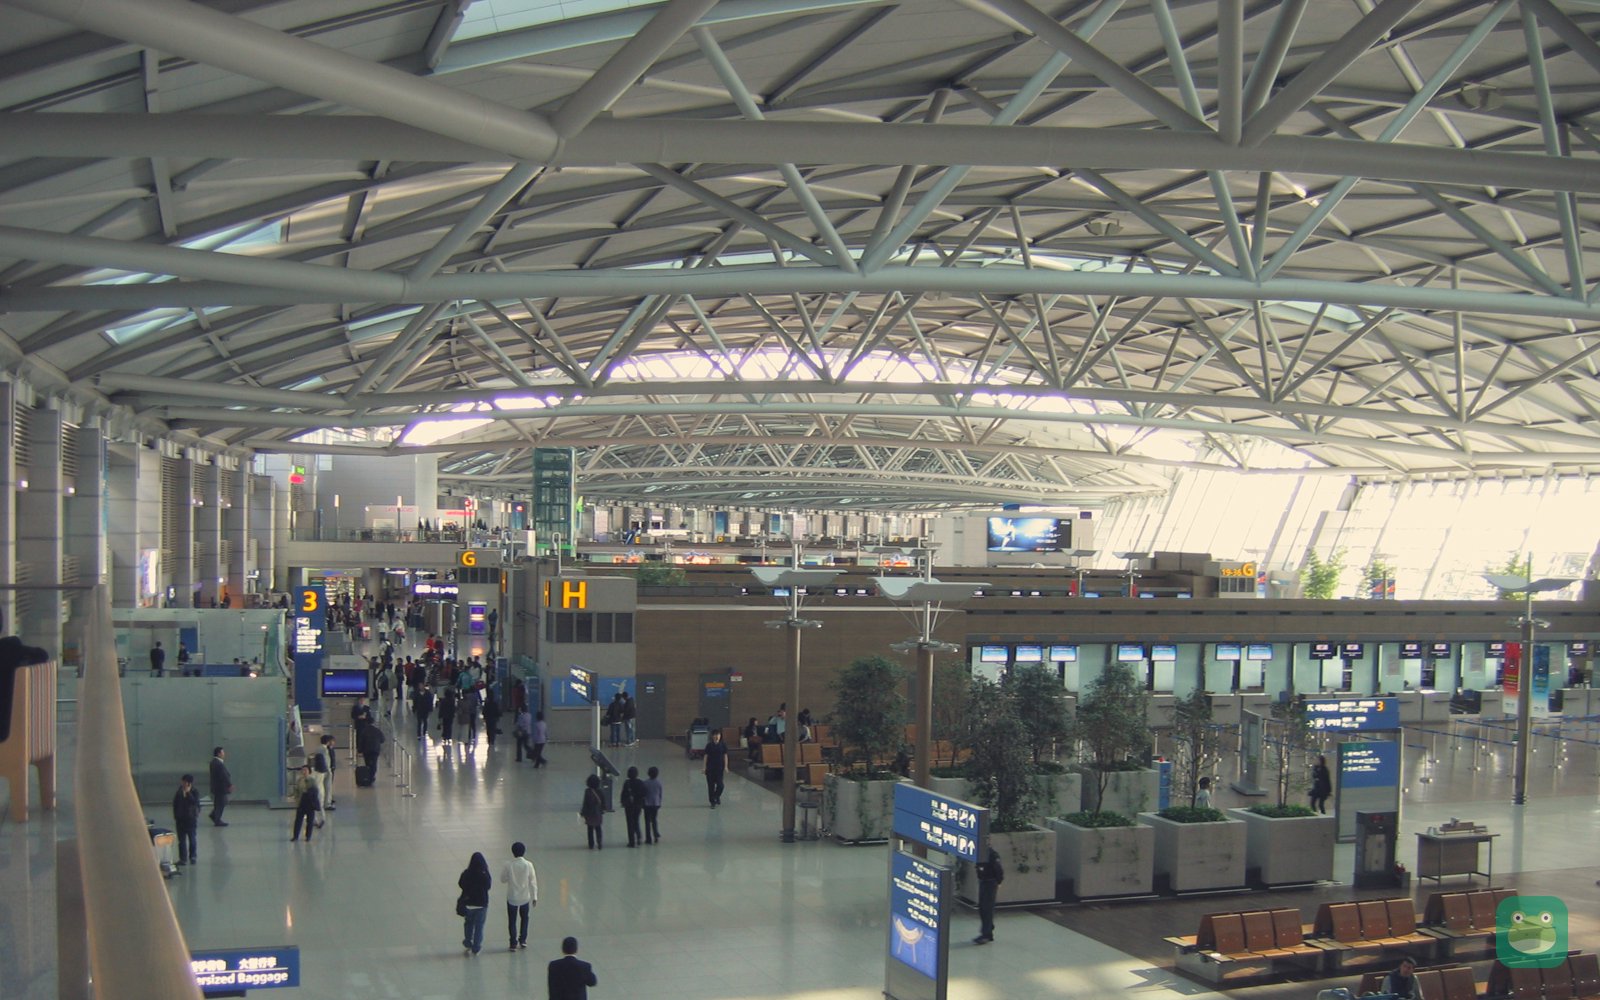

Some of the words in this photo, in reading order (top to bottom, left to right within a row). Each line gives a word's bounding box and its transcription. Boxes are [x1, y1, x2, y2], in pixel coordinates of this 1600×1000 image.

[461, 551, 477, 567] G
[1242, 563, 1254, 577] G
[303, 591, 318, 612] 3
[562, 581, 587, 609] H
[1376, 701, 1385, 712] 3
[238, 972, 288, 985] Baggage
